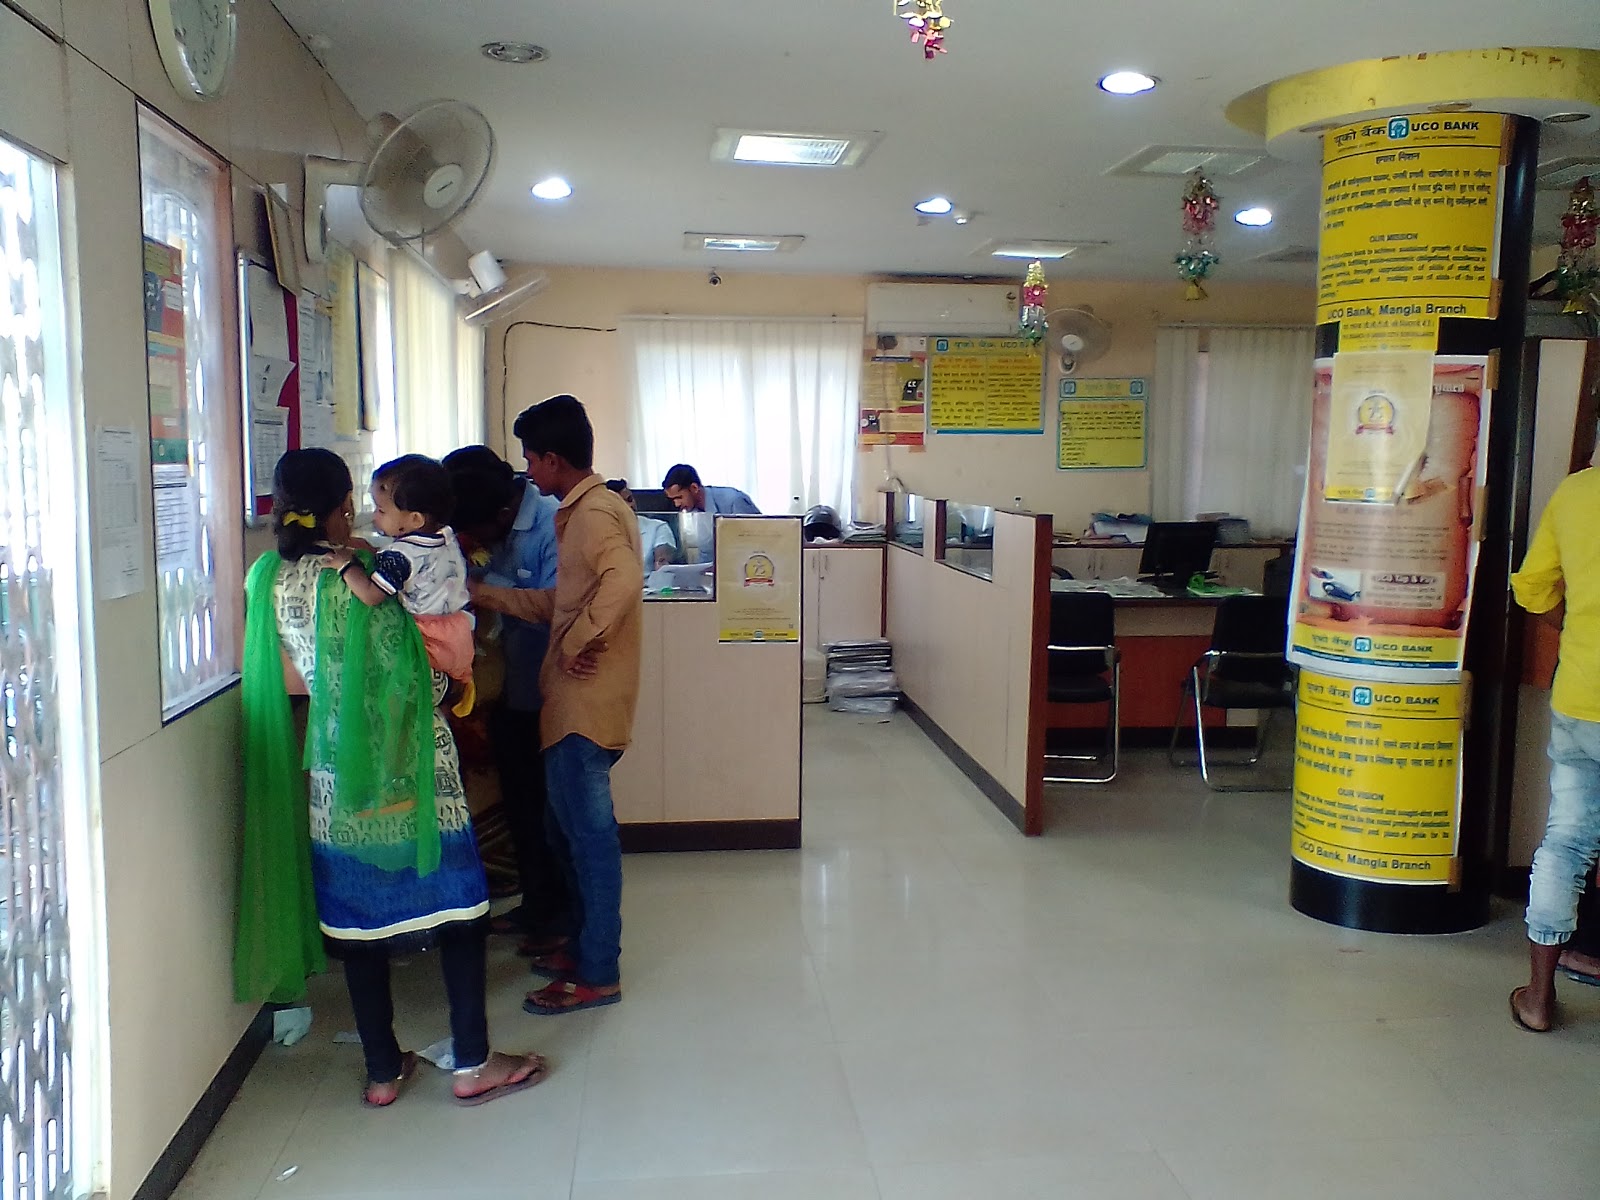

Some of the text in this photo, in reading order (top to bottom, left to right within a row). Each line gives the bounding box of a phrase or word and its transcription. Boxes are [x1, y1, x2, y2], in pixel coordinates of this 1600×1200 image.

[1411, 121, 1479, 131] UCO BANK
[1346, 306, 1375, 318] Bank,
[1379, 304, 1421, 316] Mangla
[1425, 303, 1466, 314] Branch
[1374, 643, 1398, 651] UCO
[1375, 694, 1440, 705] UCO BANK
[1316, 846, 1343, 862] Bank,
[1347, 853, 1388, 869] Mangla
[1391, 859, 1431, 870] Branch
